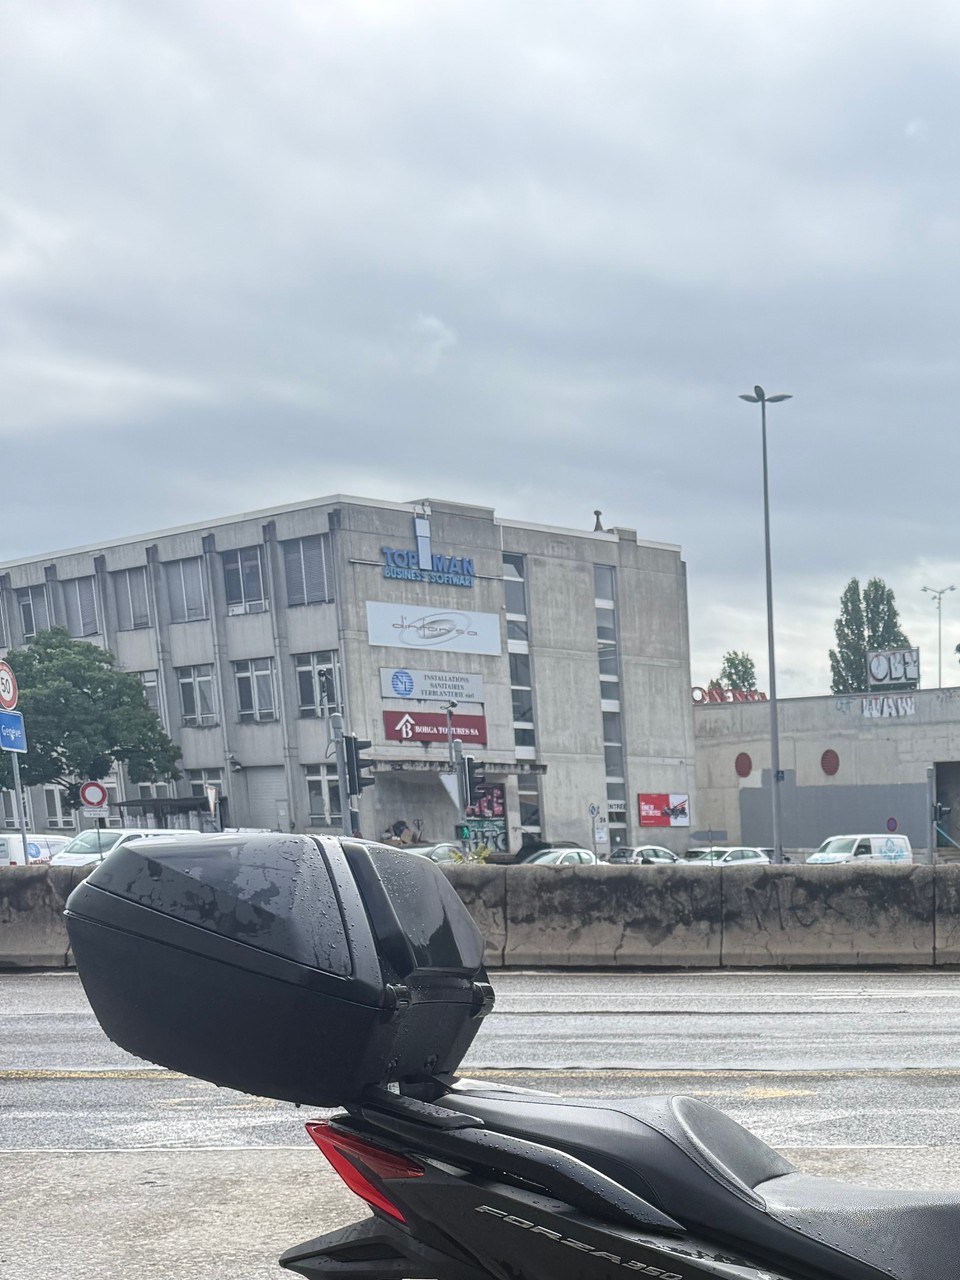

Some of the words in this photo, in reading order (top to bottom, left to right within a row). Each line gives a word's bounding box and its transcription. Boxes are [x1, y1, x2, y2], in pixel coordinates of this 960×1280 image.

[431, 554, 474, 576] MAN
[1, 677, 11, 694] 50
[415, 726, 438, 734] BORGA
[438, 726, 470, 736] TOTURES
